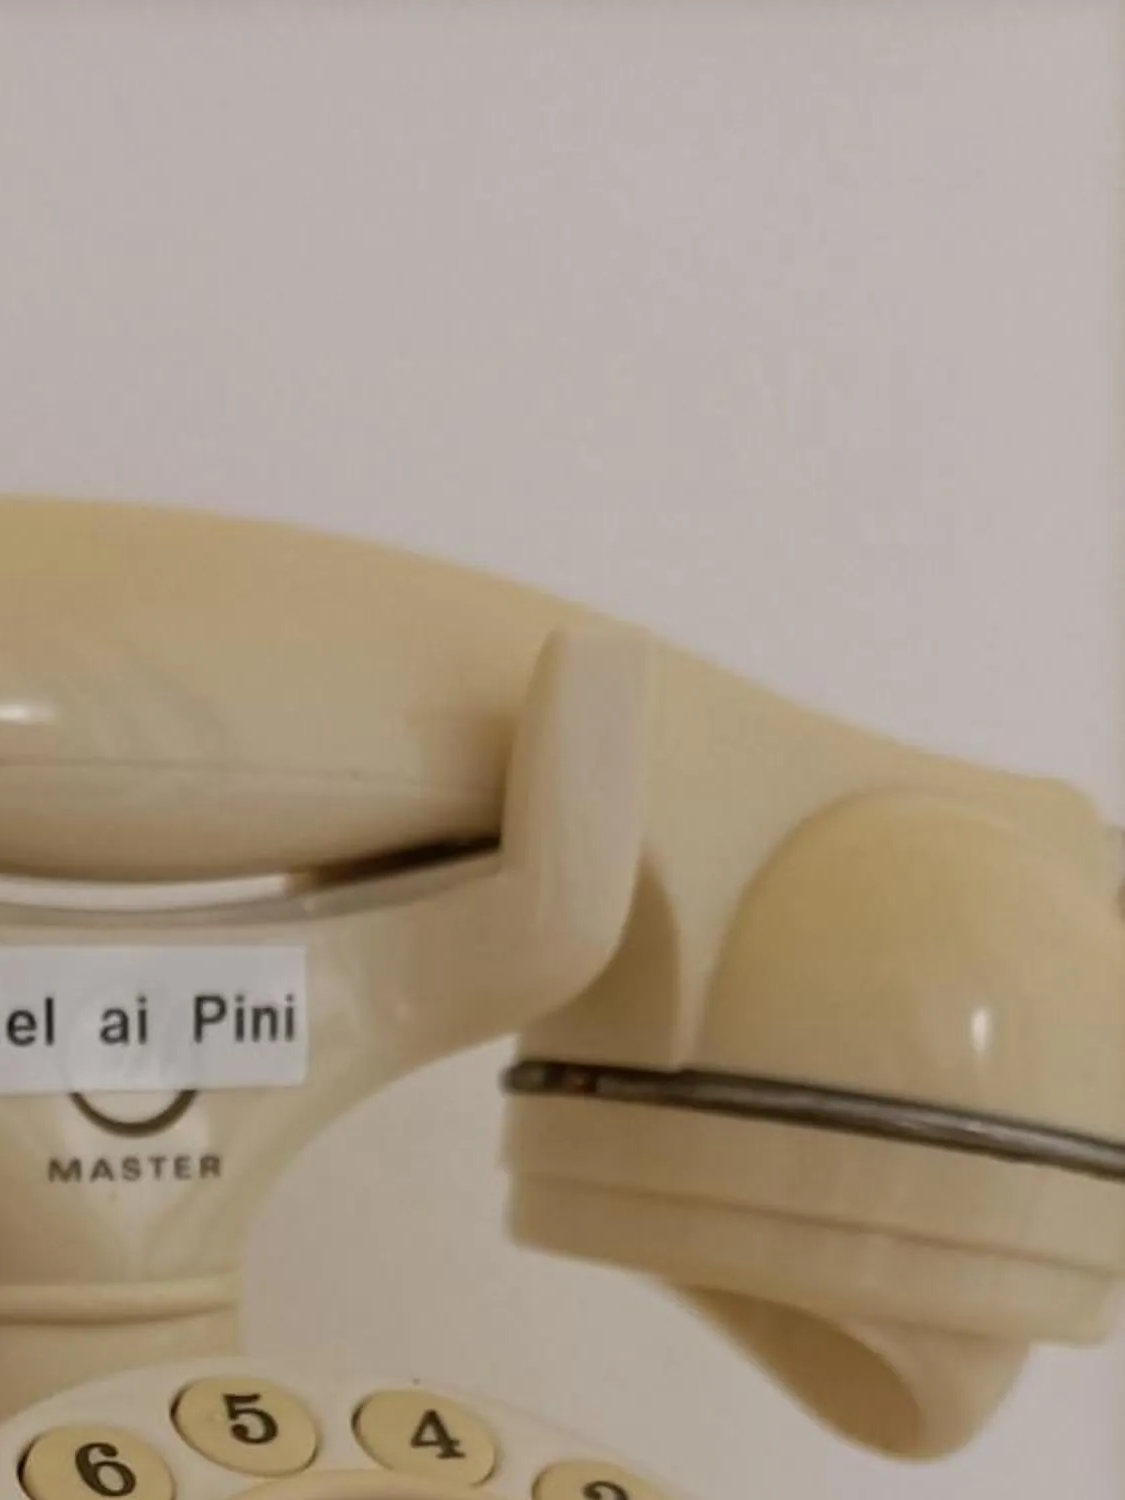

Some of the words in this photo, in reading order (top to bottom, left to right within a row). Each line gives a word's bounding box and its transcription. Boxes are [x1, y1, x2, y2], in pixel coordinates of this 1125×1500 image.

[99, 996, 148, 1045] ai
[193, 994, 294, 1043] Pini
[47, 1154, 221, 1184] MASTER
[222, 1393, 279, 1445] 5
[410, 1409, 465, 1460] 4
[74, 1442, 137, 1498] 6
